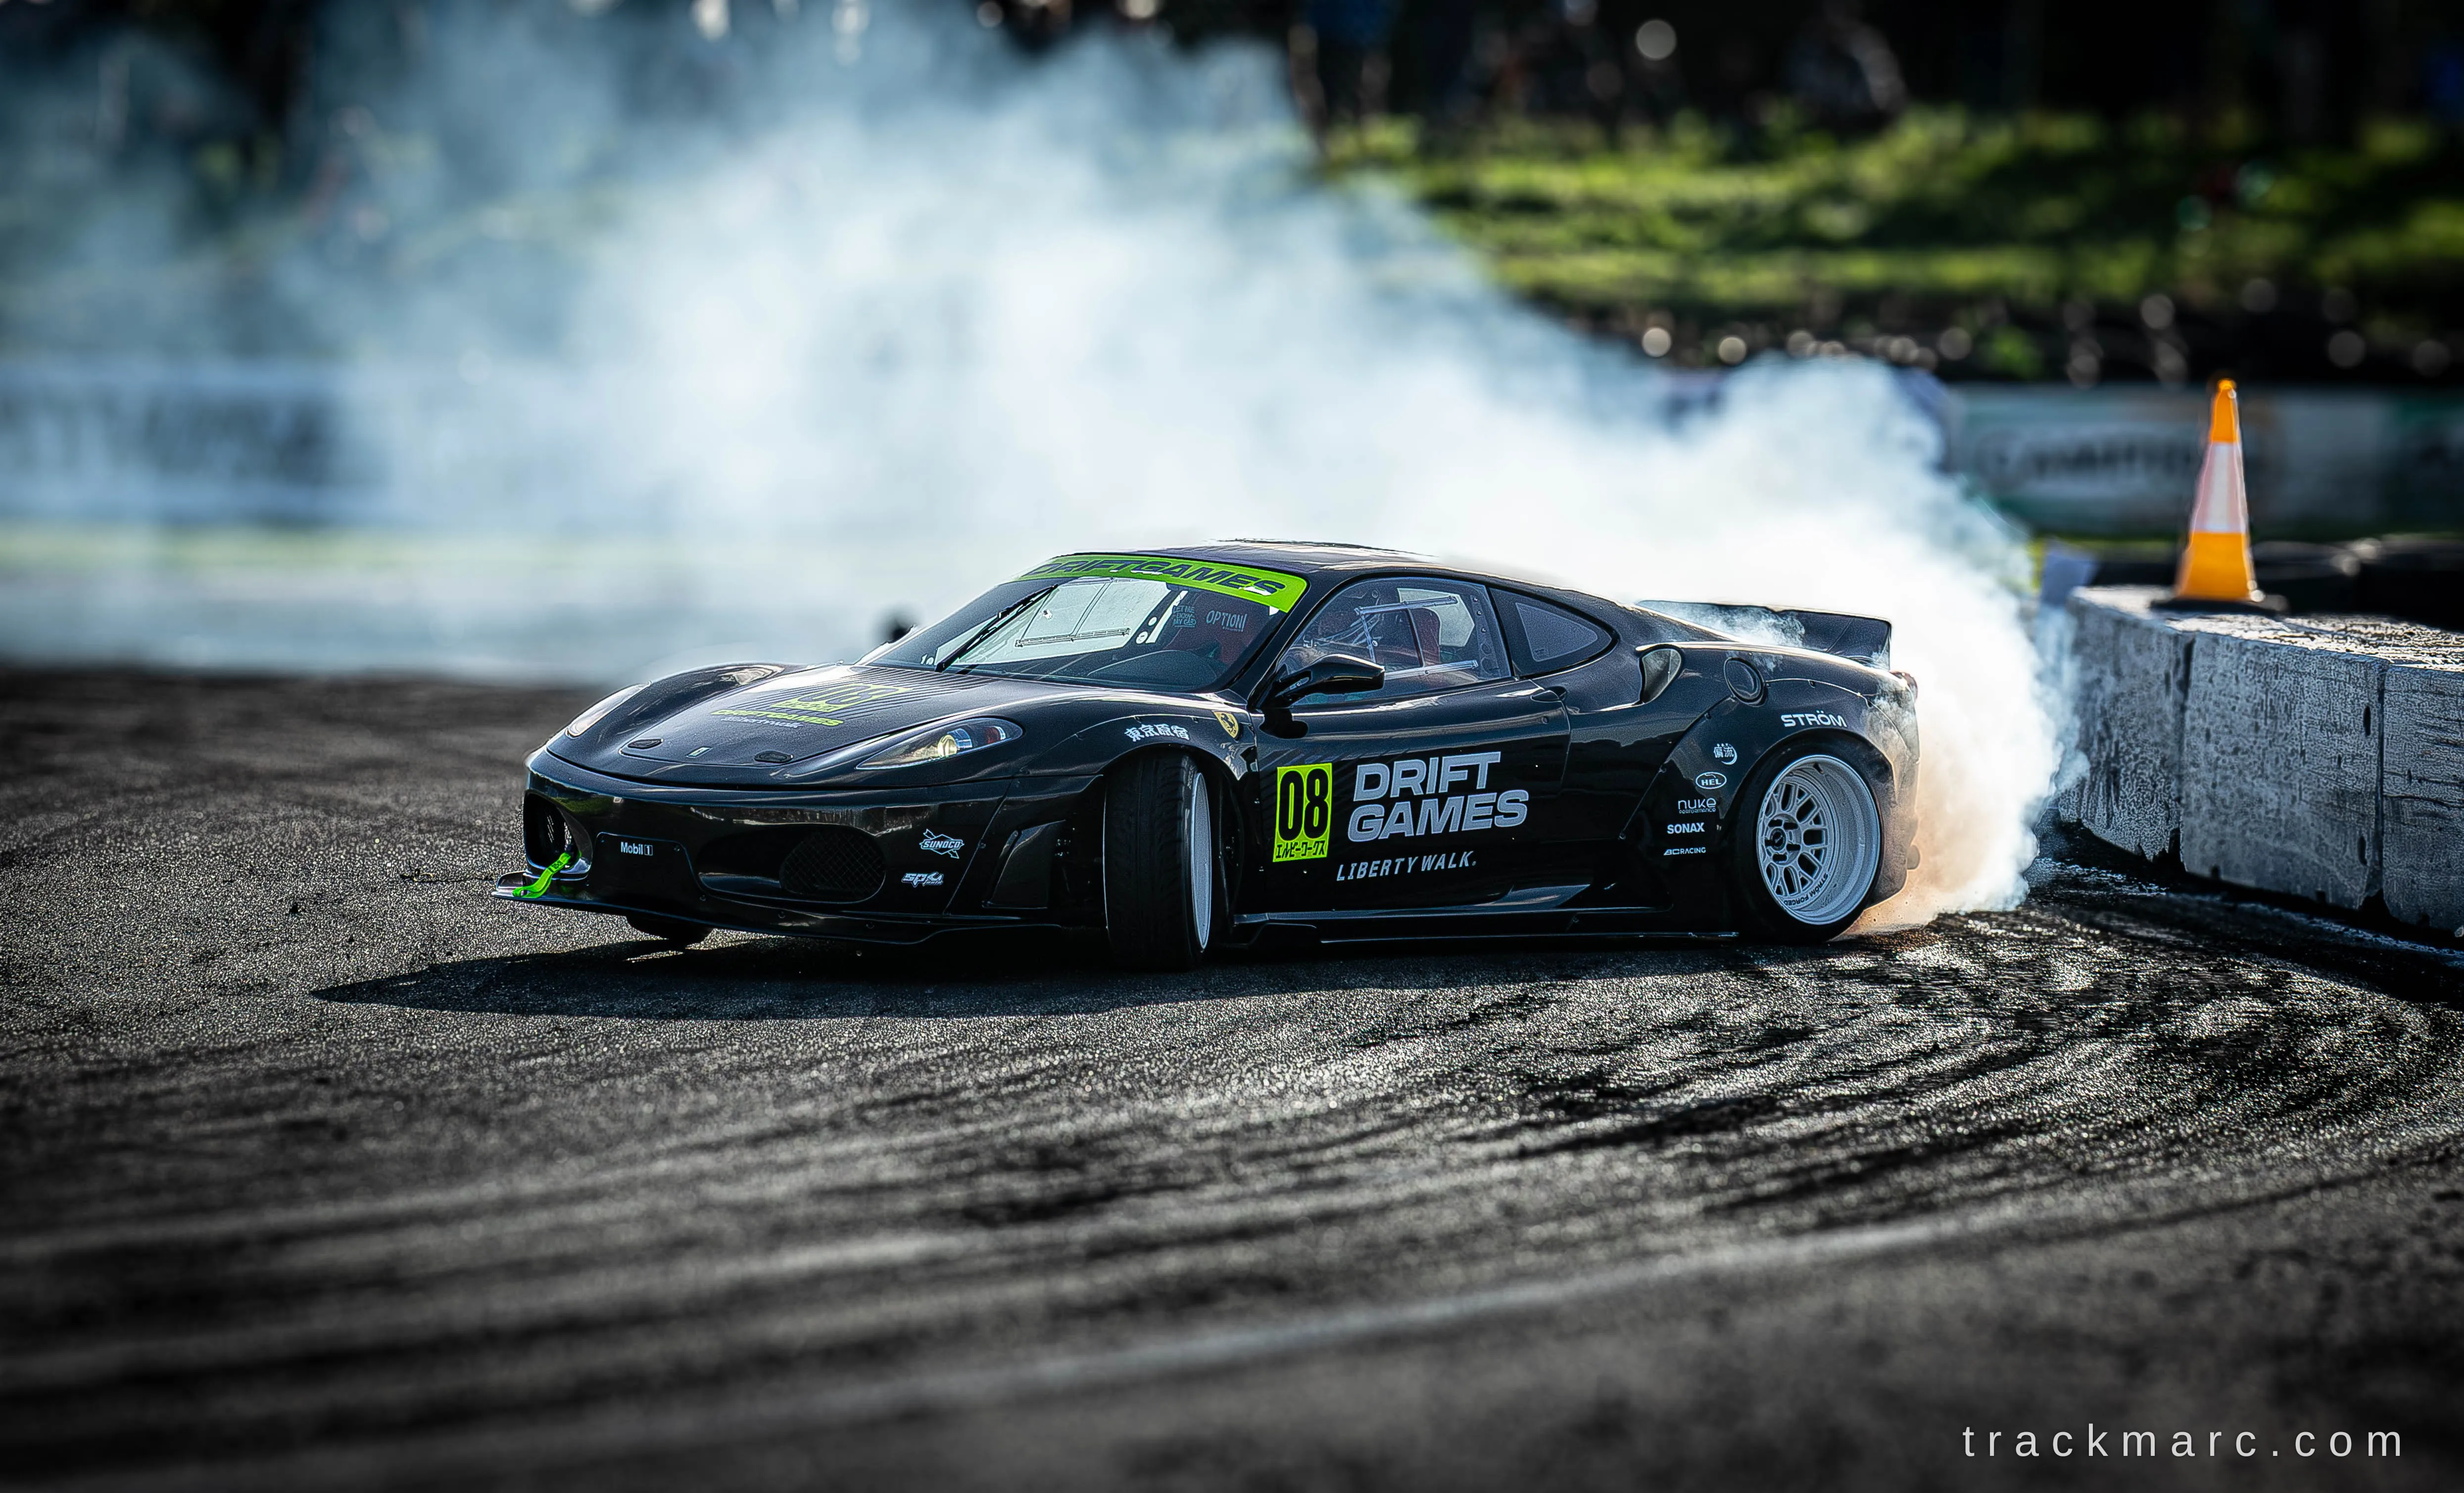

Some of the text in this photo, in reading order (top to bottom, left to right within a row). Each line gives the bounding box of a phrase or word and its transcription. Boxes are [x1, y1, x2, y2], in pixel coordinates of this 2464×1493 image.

[1031, 559, 1286, 594] DRIFTGAMES
[711, 709, 844, 726] DRIFTGAMES
[1781, 710, 1847, 727] STRÖM
[1353, 752, 1501, 801] DRIFT
[1278, 767, 1329, 841] 08
[1678, 798, 1716, 810] nuke
[1348, 790, 1529, 842] GAMES
[1667, 822, 1705, 834] SONAX
[621, 842, 643, 855] Mobil
[1336, 856, 1419, 881] LIBERTY
[1784, 894, 1809, 906] FORGED
